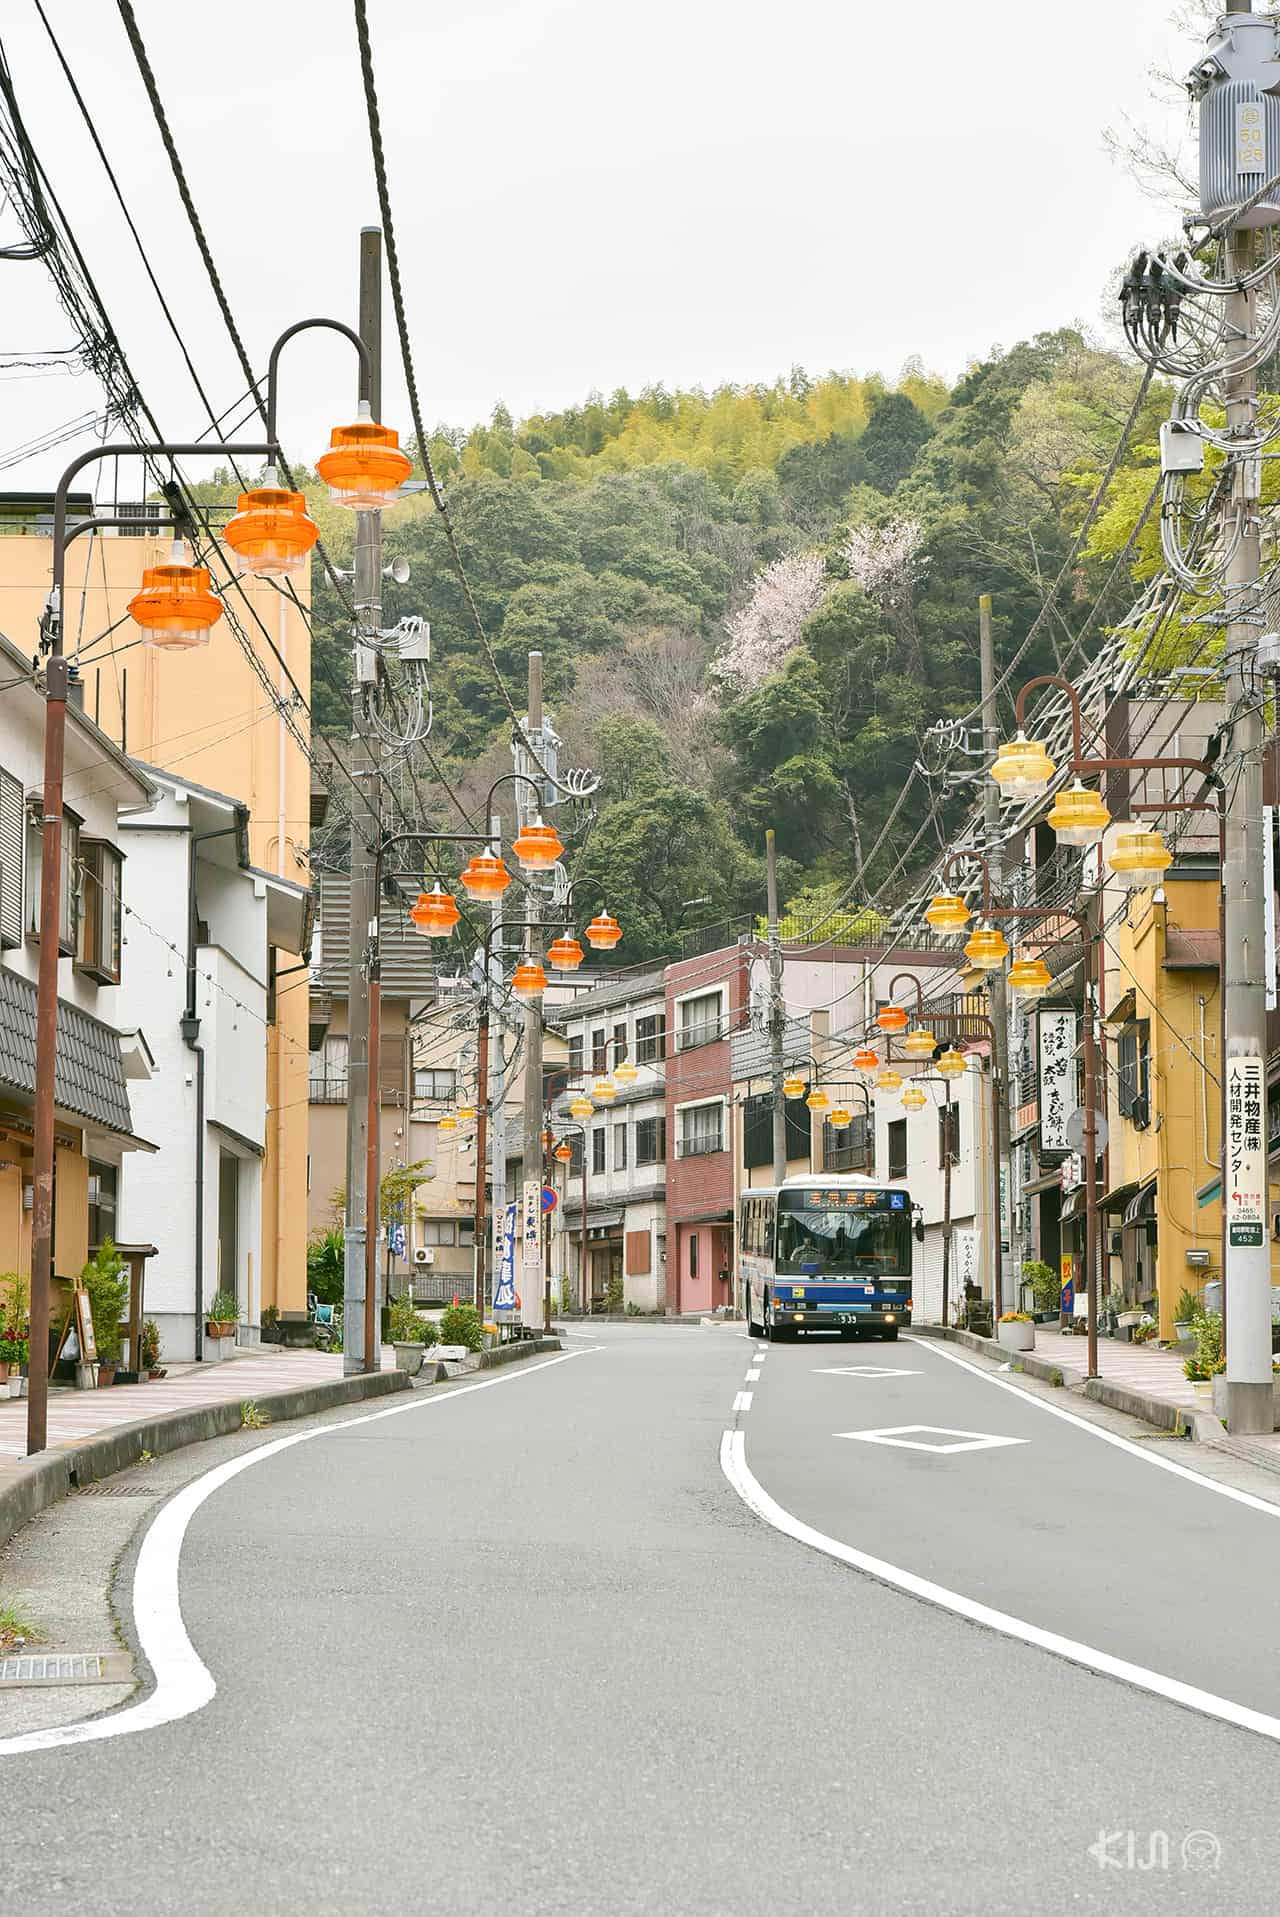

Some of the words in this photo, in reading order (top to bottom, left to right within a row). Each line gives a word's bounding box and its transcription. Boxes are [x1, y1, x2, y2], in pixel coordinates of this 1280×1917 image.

[1230, 1067, 1242, 1187] 人材開発センター
